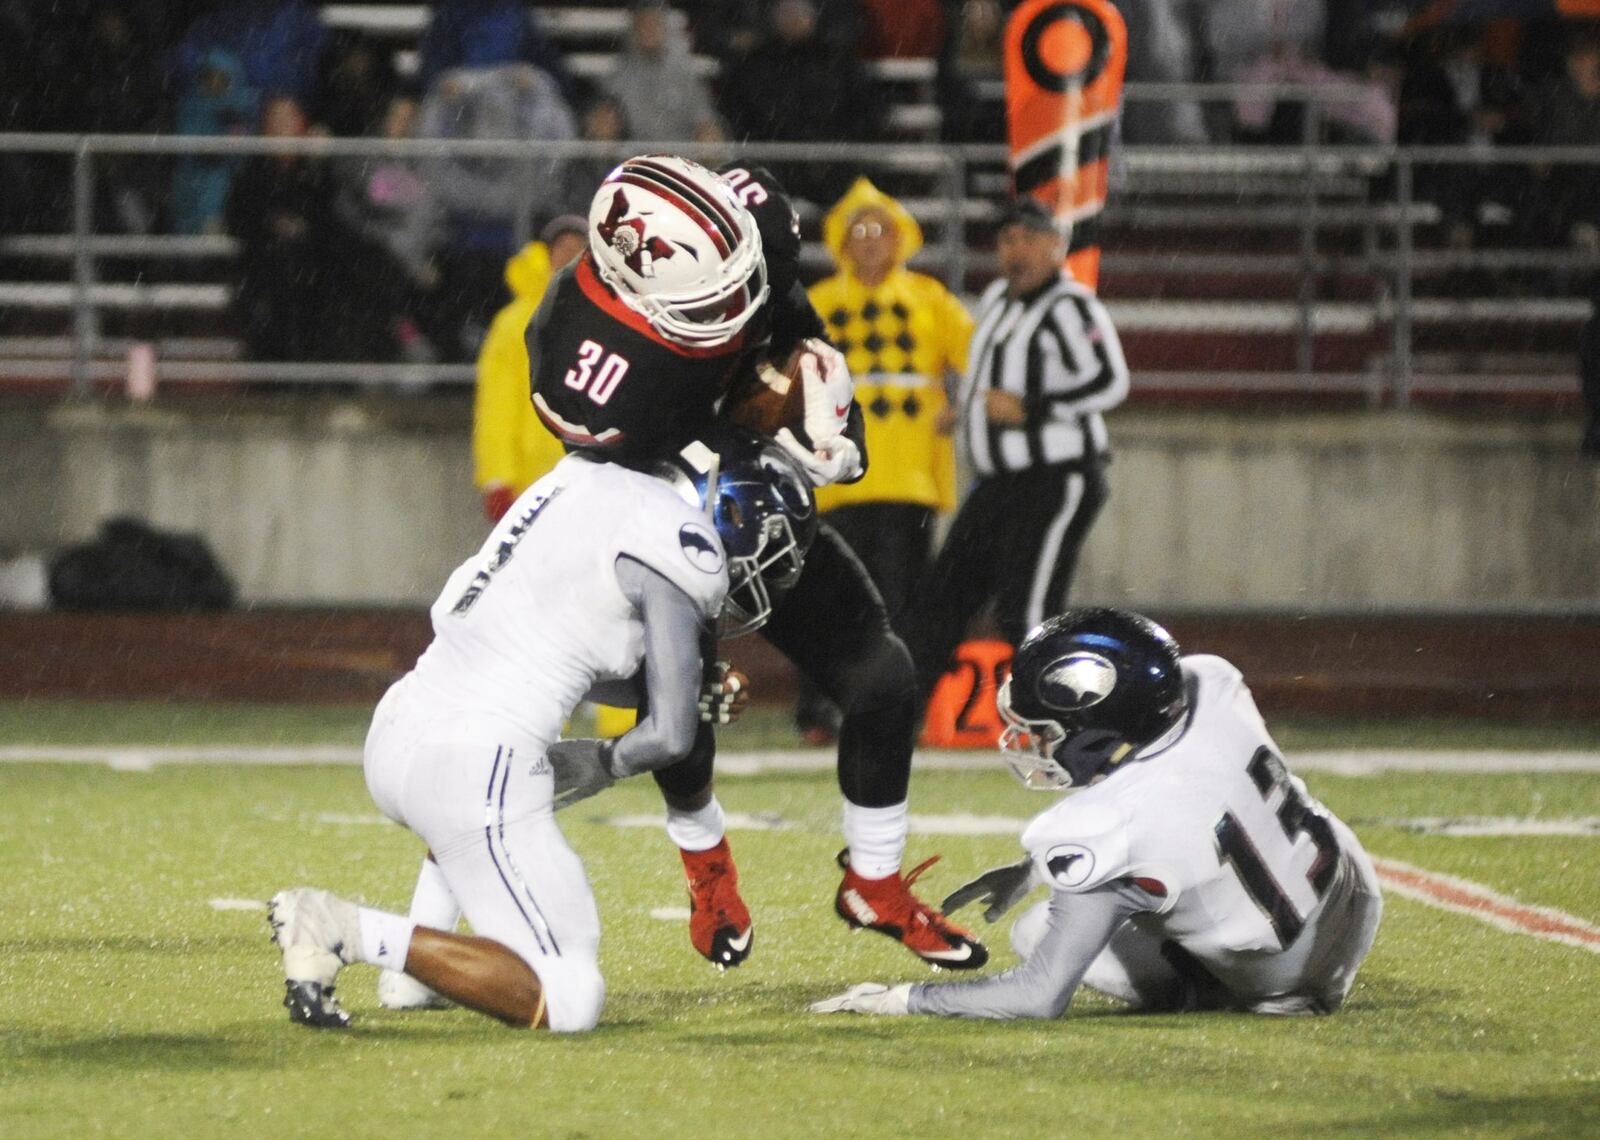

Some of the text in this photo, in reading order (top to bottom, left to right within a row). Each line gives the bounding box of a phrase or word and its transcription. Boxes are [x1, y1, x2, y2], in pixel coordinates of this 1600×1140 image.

[563, 339, 630, 406] 30
[954, 658, 1012, 733] 2
[1214, 744, 1341, 951] 13
